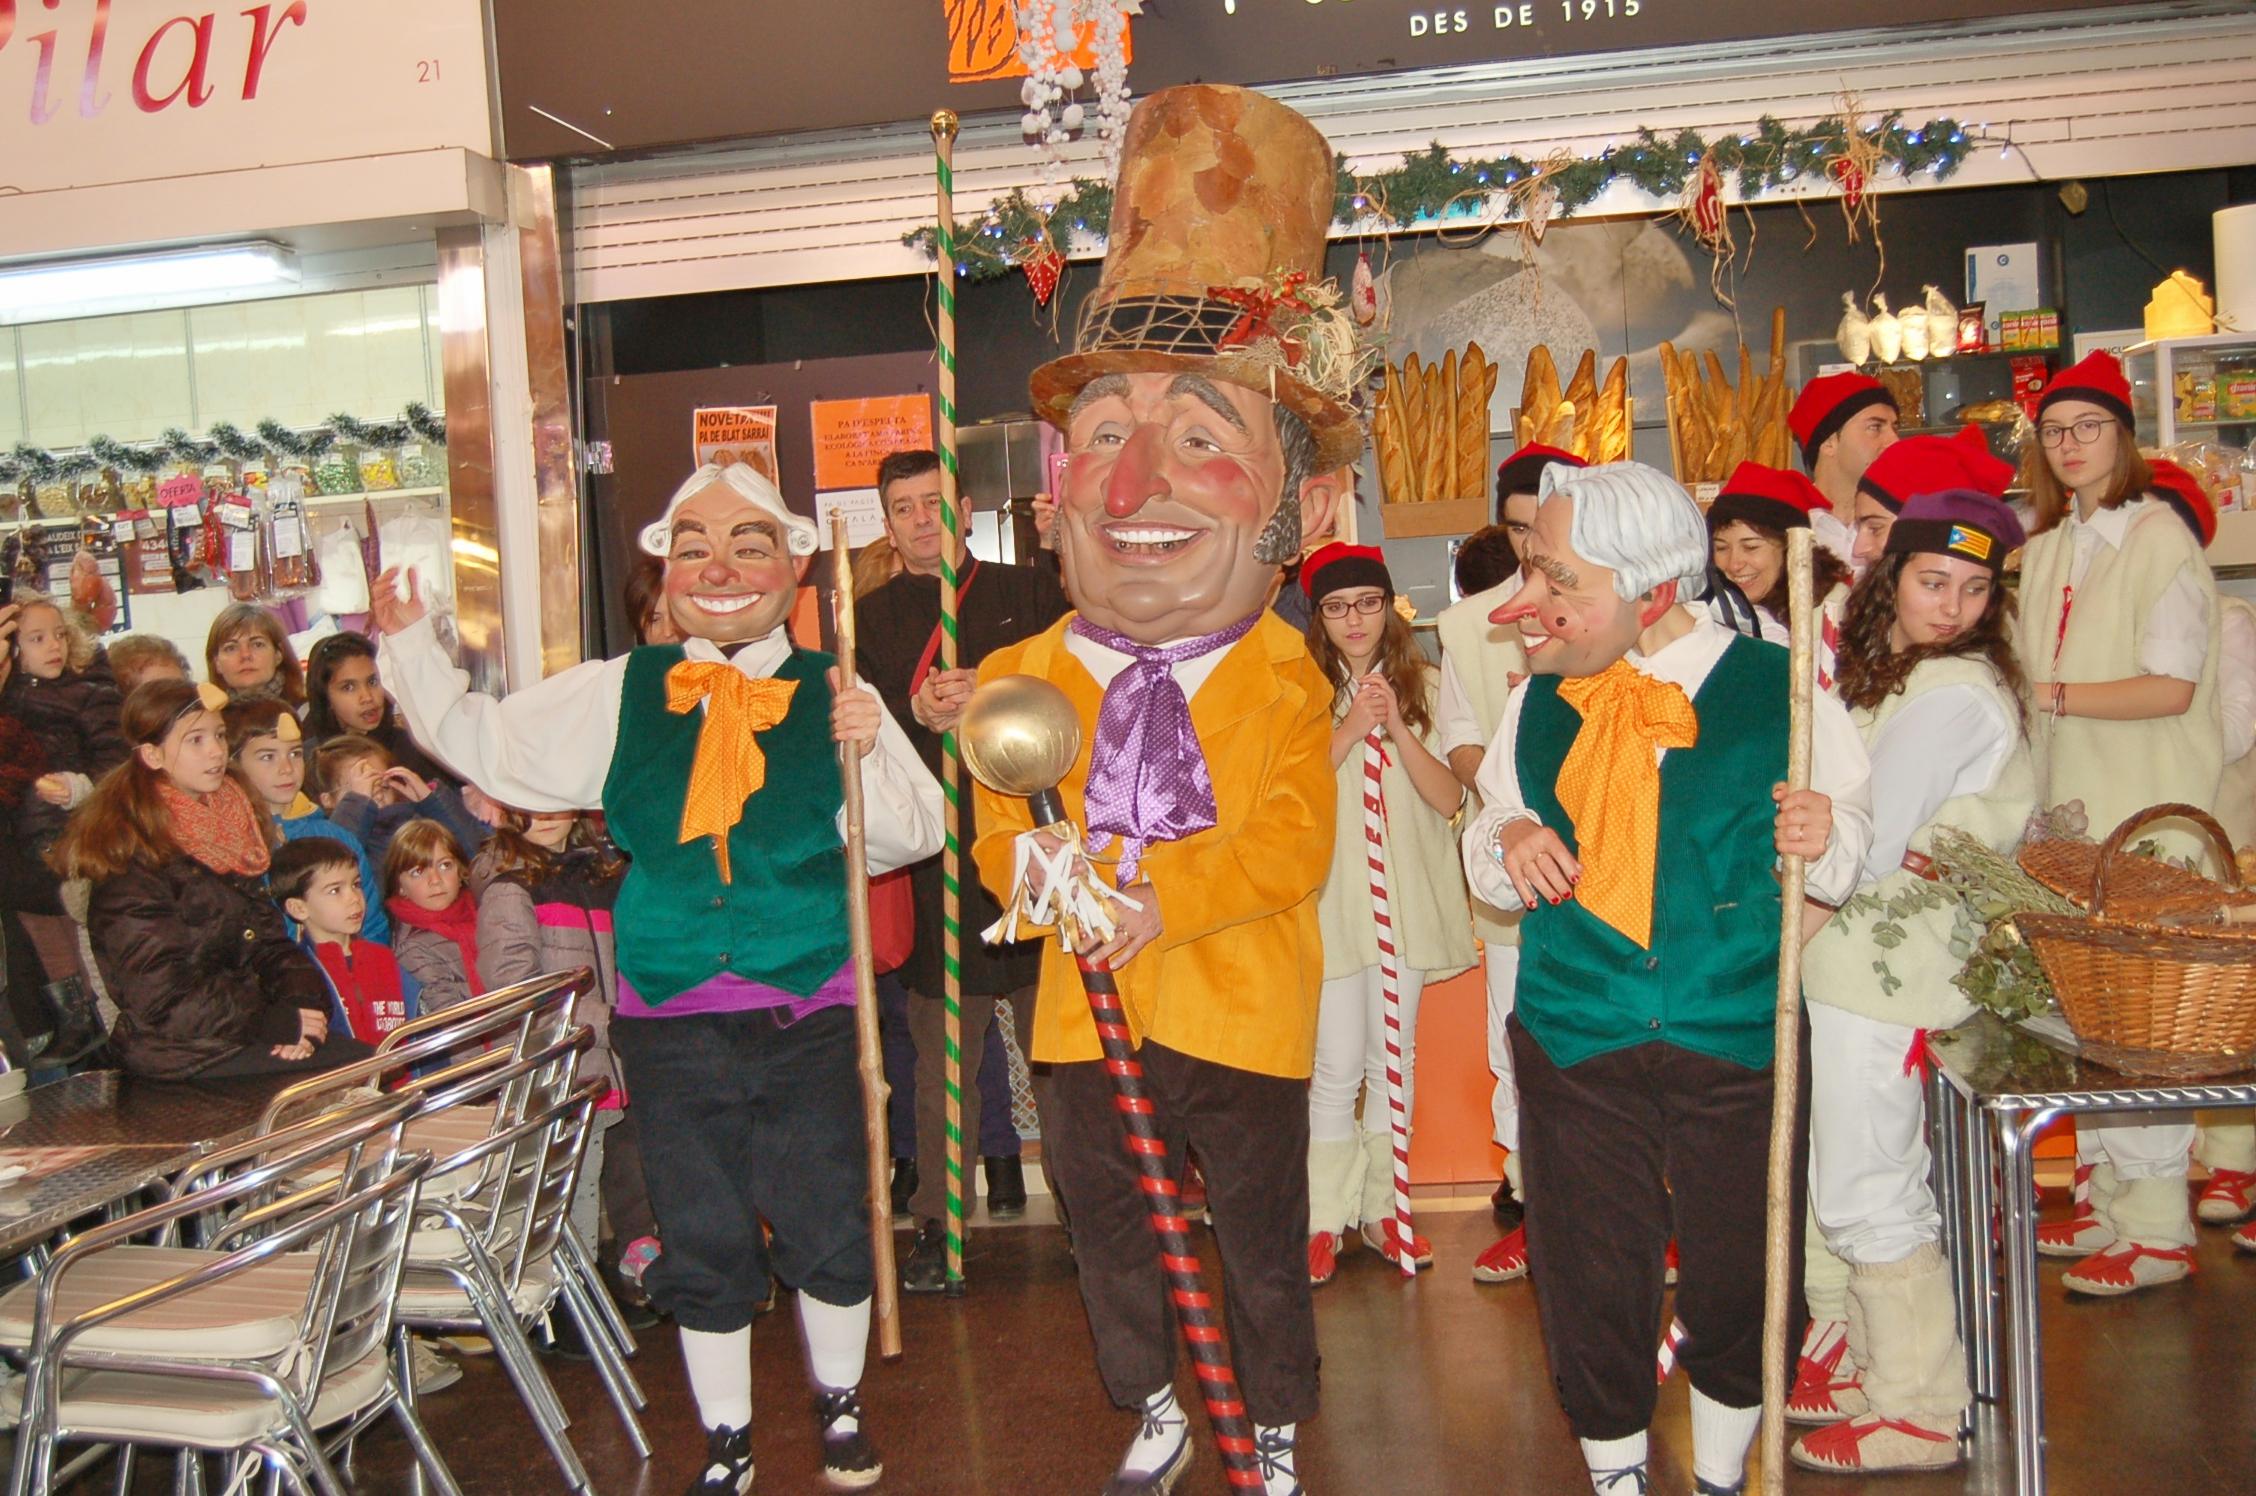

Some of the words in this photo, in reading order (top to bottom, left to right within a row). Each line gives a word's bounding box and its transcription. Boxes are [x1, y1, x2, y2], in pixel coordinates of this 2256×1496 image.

[1409, 11, 1468, 37] DES
[1494, 4, 1534, 29] DE
[1561, 0, 1641, 22] 1915
[416, 59, 441, 83] 21
[699, 431, 709, 443] PA
[710, 430, 721, 442] DE
[721, 428, 740, 442] BLAT
[160, 483, 196, 499] OFERTA
[142, 540, 168, 551] 434
